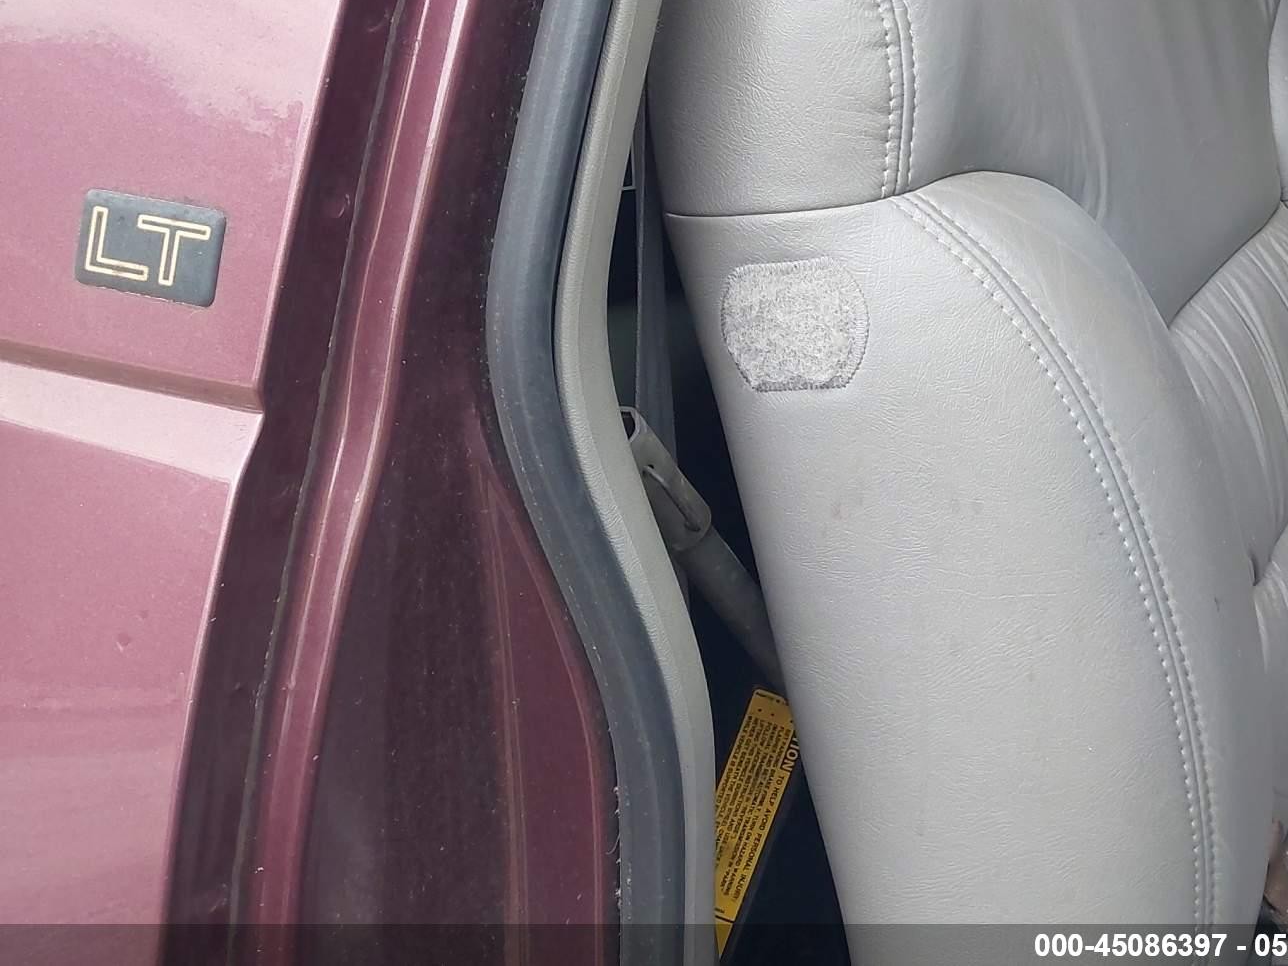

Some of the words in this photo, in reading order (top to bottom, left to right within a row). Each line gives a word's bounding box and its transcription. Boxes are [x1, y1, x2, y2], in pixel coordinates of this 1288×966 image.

[85, 205, 211, 286] LT
[767, 786, 780, 806] HELP
[758, 808, 771, 831] AVOID
[734, 841, 748, 867] HAZARD
[742, 832, 762, 872] PERSONAL
